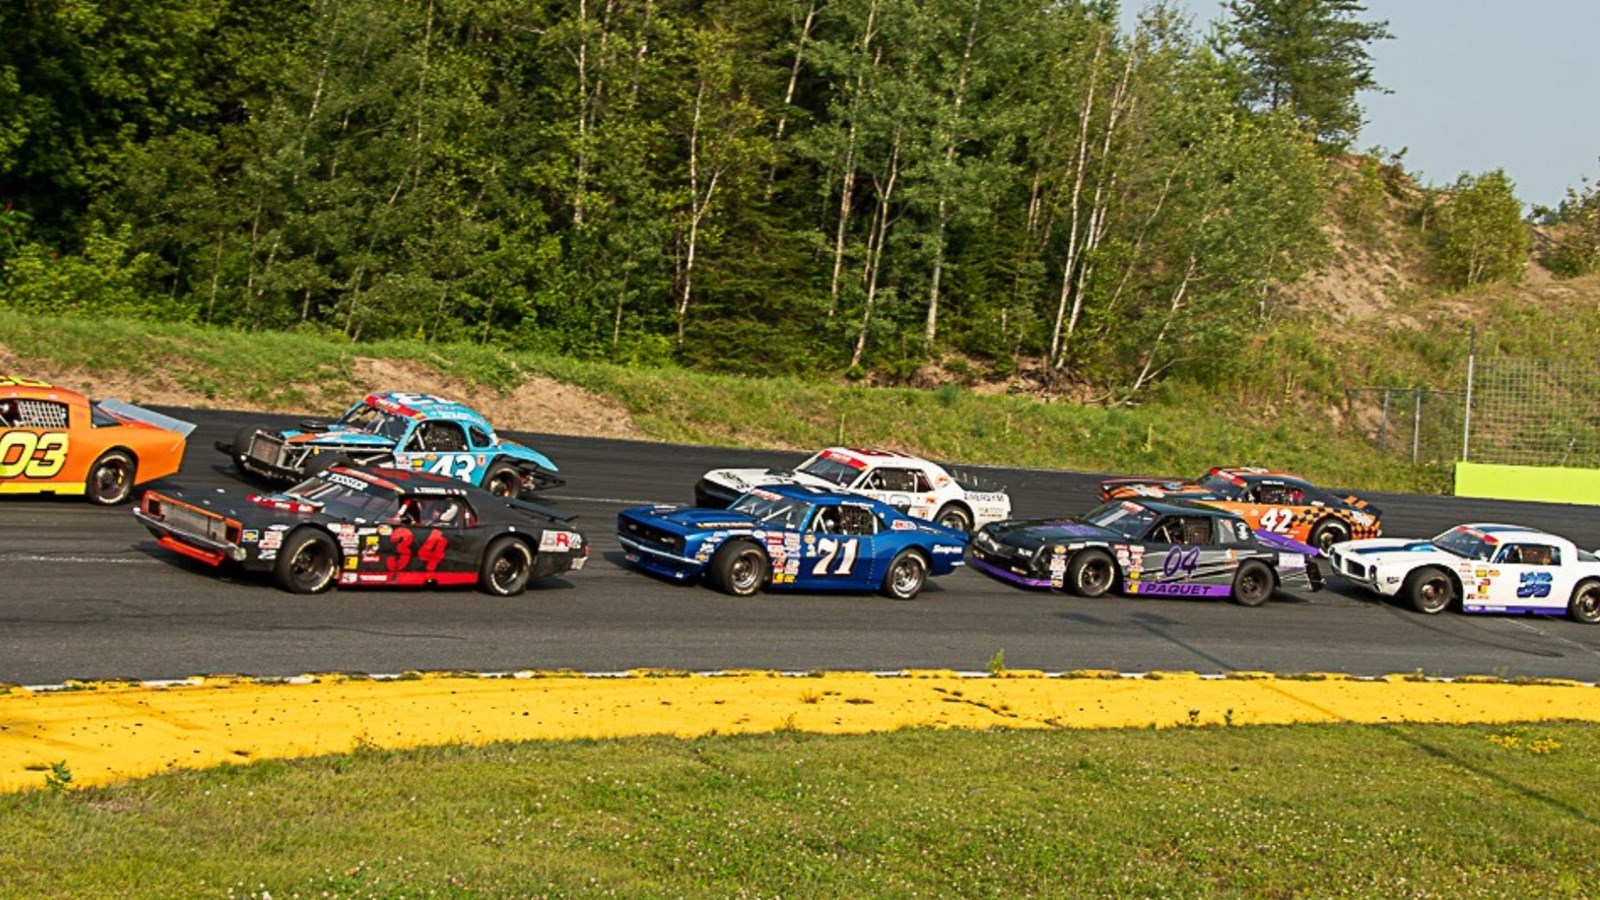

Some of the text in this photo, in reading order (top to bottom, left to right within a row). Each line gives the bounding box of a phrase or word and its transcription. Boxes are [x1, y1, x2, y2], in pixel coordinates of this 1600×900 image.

[0, 430, 69, 478] 03
[428, 454, 476, 482] 43
[1259, 507, 1294, 533] 42
[385, 526, 449, 572] 34
[811, 537, 860, 577] 71
[1163, 544, 1201, 578] 04
[1144, 583, 1212, 595] PAQUET
